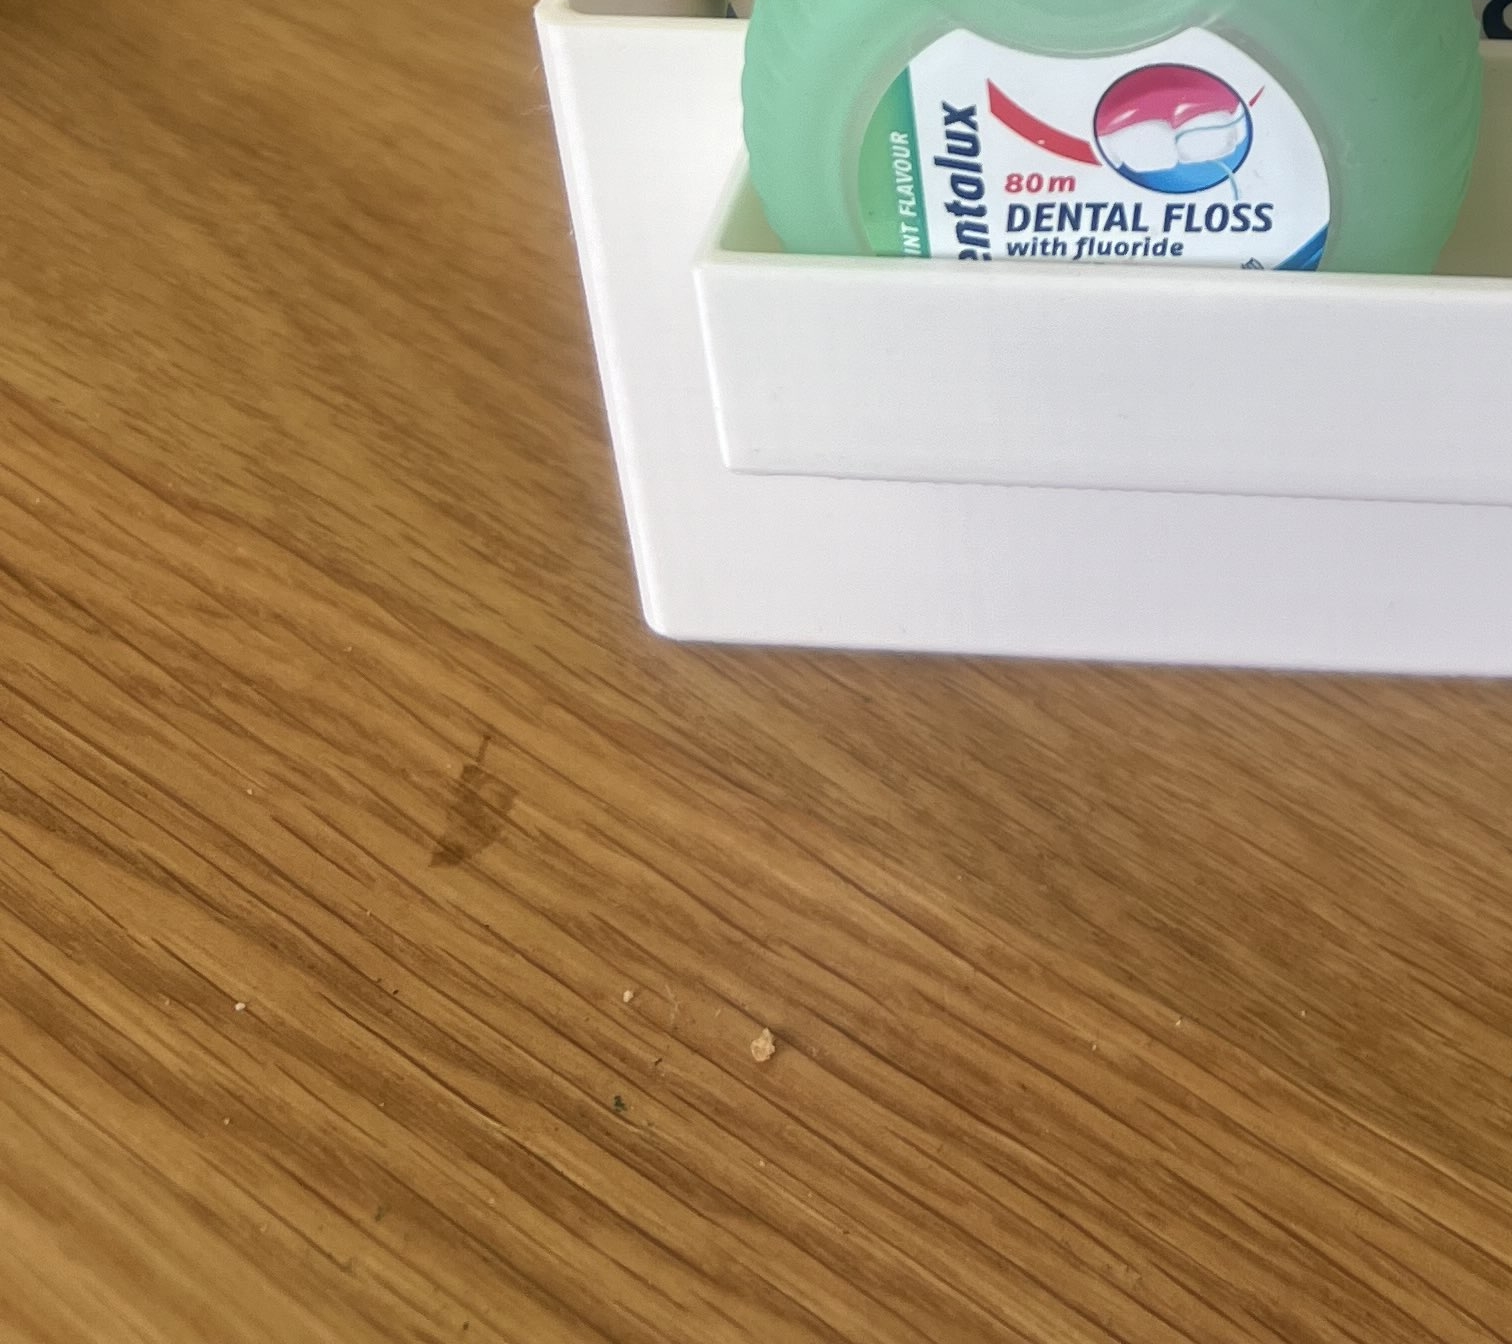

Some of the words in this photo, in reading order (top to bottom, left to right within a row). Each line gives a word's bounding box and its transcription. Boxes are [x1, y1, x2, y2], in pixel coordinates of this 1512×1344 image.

[889, 130, 917, 218] FLAVOUR
[1004, 172, 1044, 194] 80
[1048, 174, 1076, 193] m
[1006, 201, 1149, 233] DENTAL
[1163, 201, 1275, 233] FLOSS
[1006, 237, 1068, 257] with
[1073, 236, 1184, 260] fluoride
